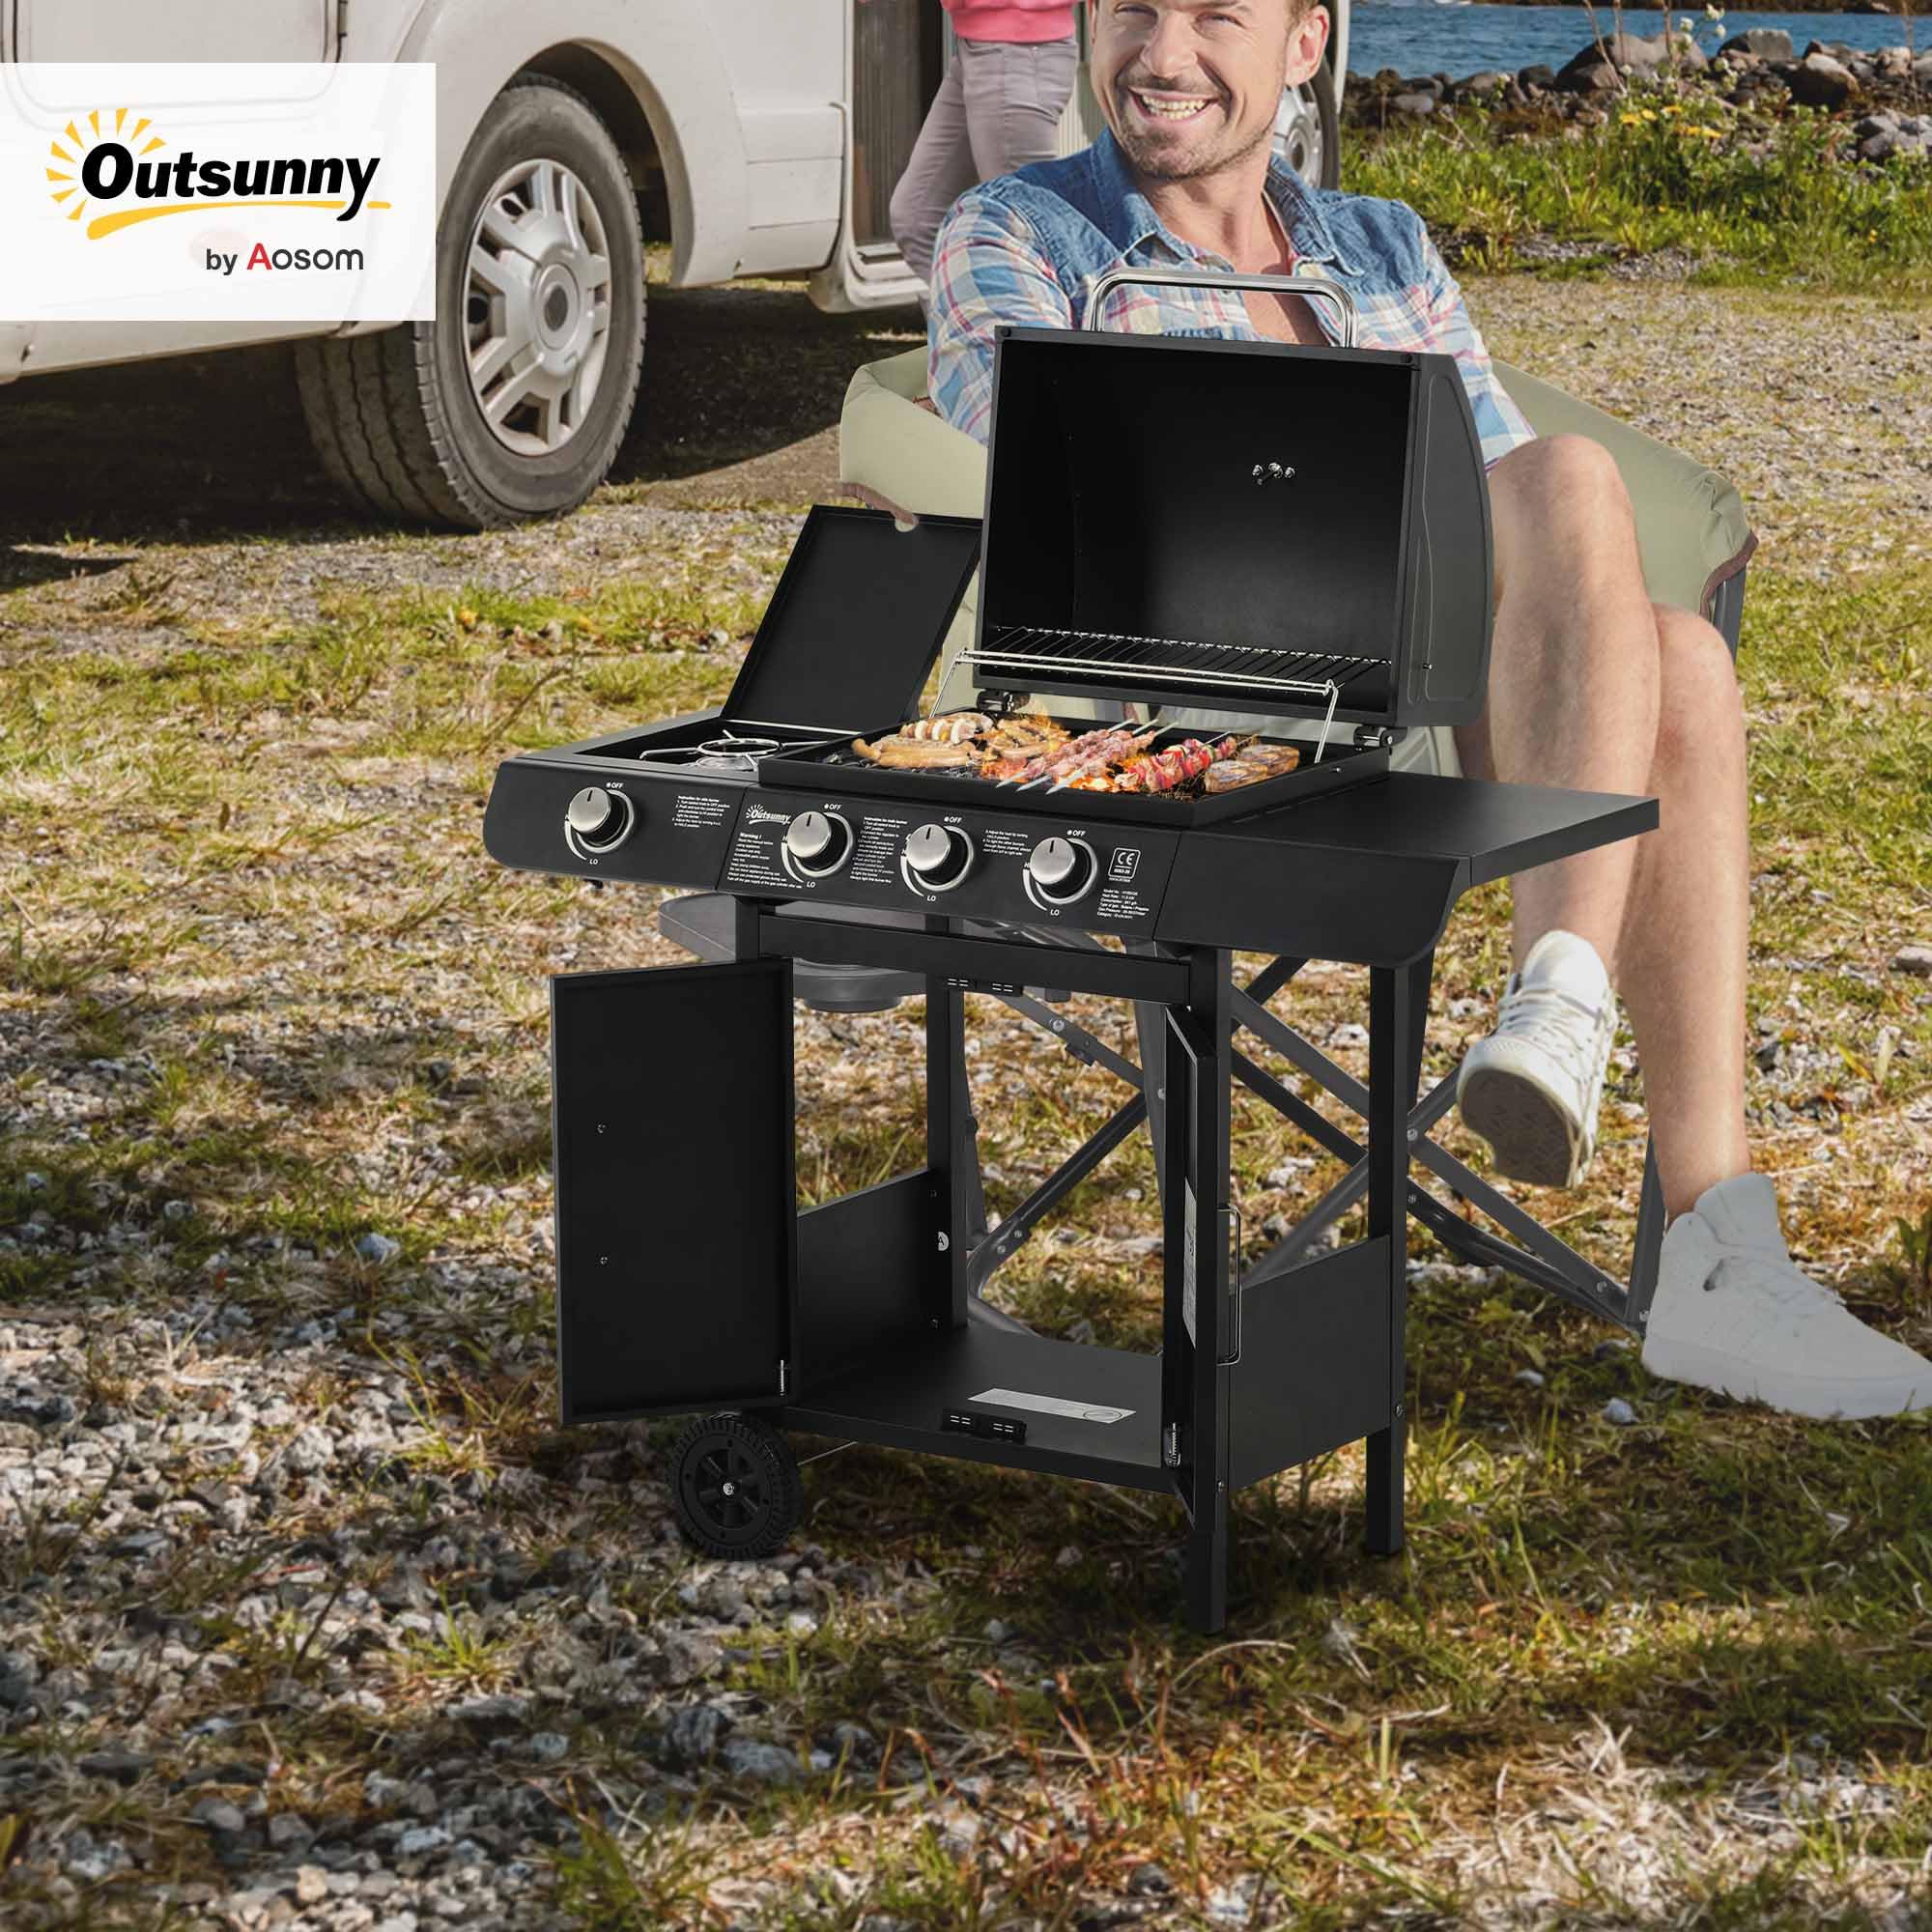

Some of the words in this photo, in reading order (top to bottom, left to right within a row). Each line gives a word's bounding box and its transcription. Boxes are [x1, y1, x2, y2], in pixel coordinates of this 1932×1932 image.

[829, 803, 842, 811] OFF
[751, 809, 791, 825] Outsunny
[1117, 851, 1136, 867] CE
